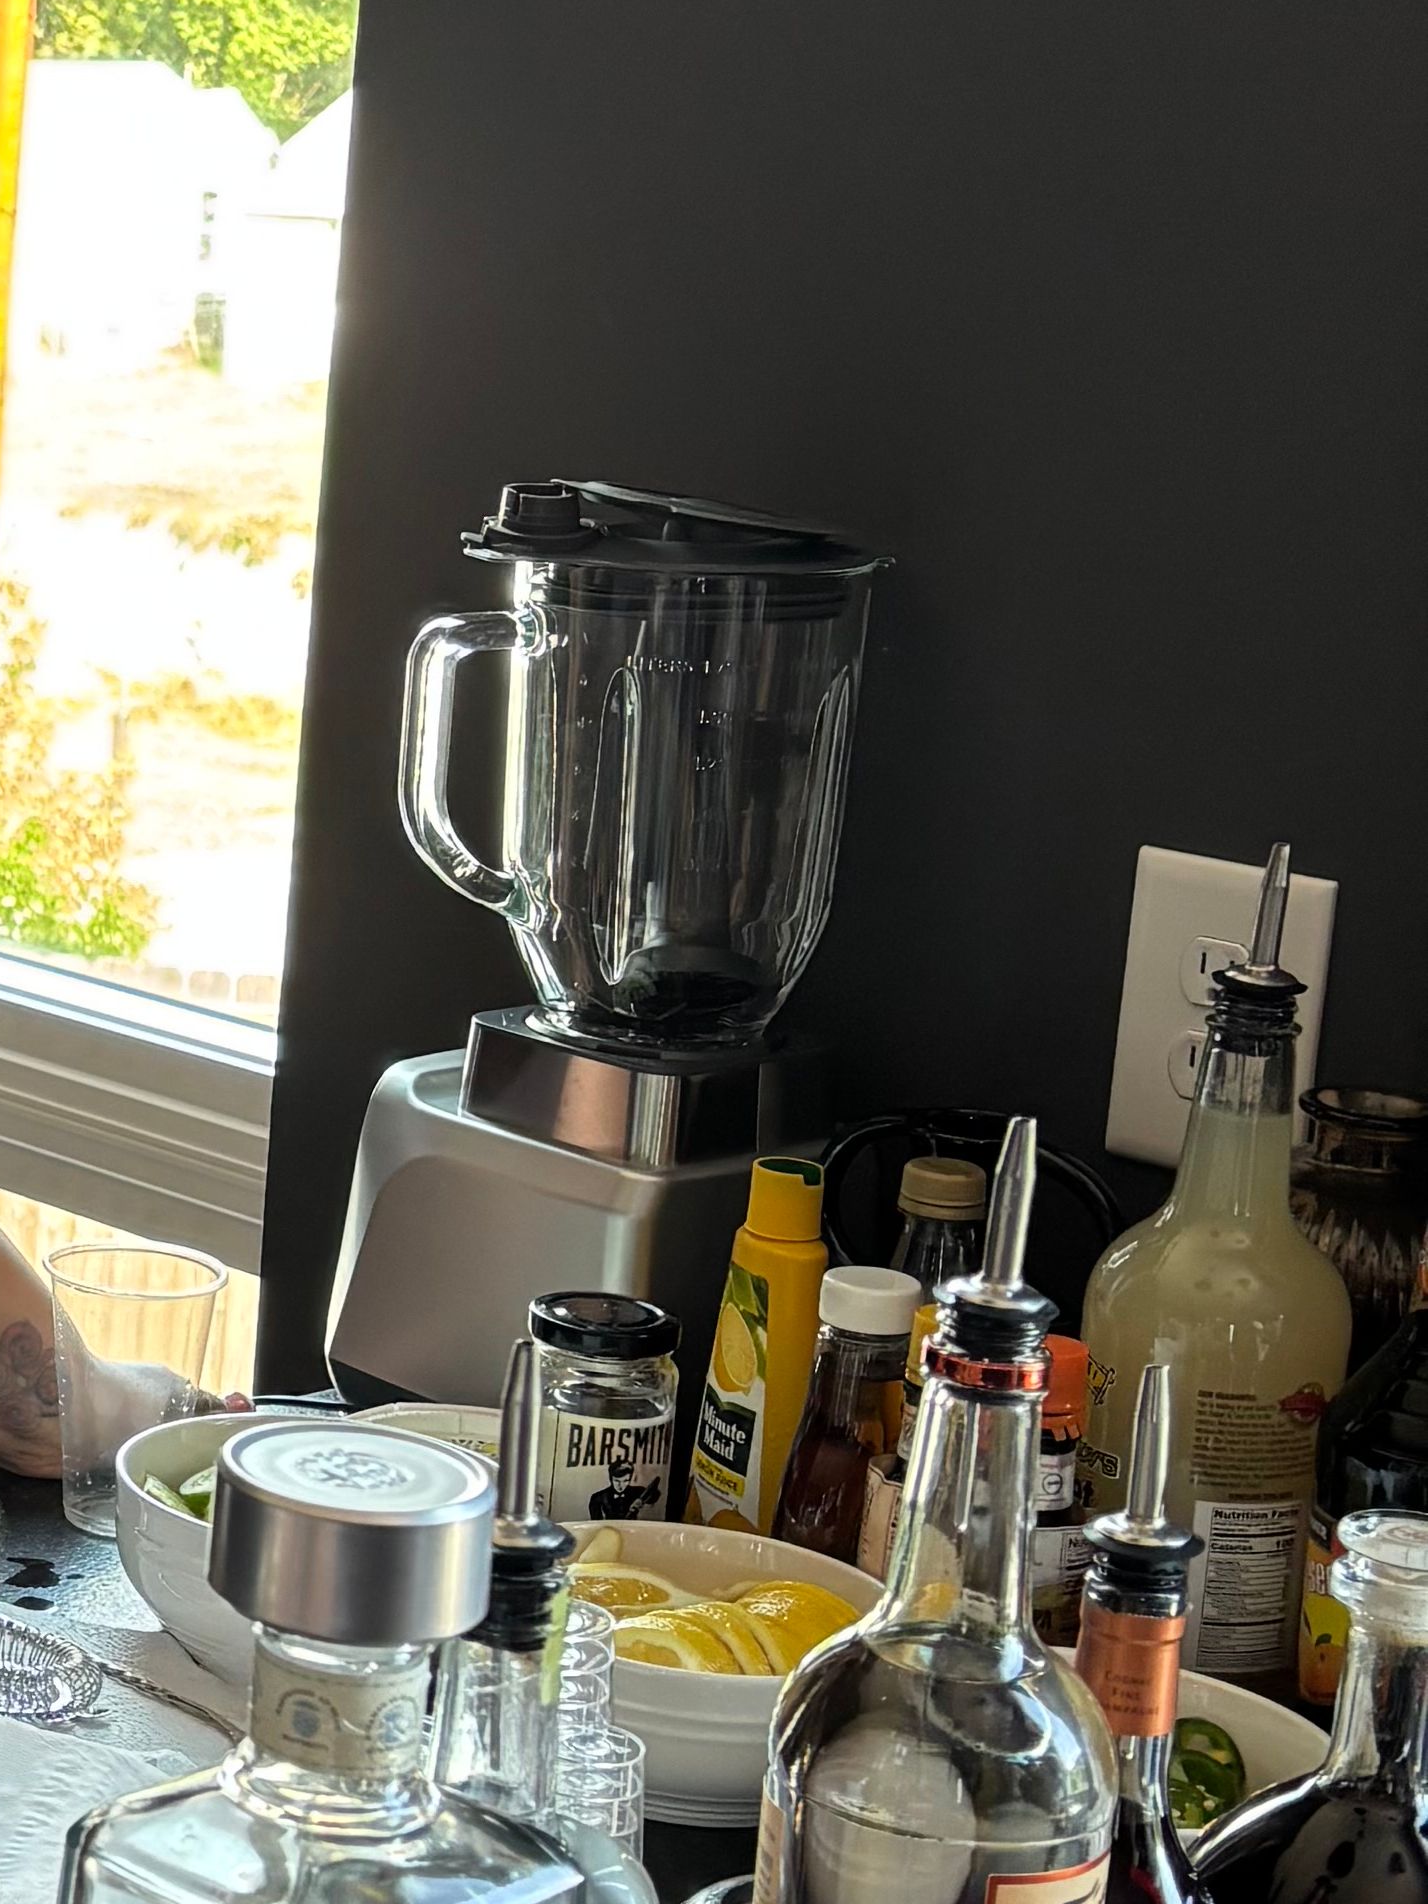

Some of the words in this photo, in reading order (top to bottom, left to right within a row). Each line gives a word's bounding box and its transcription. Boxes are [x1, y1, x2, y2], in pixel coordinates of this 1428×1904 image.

[704, 1399, 746, 1445] Minute
[702, 1426, 735, 1462] Maid
[1213, 1508, 1267, 1521] Nutrition
